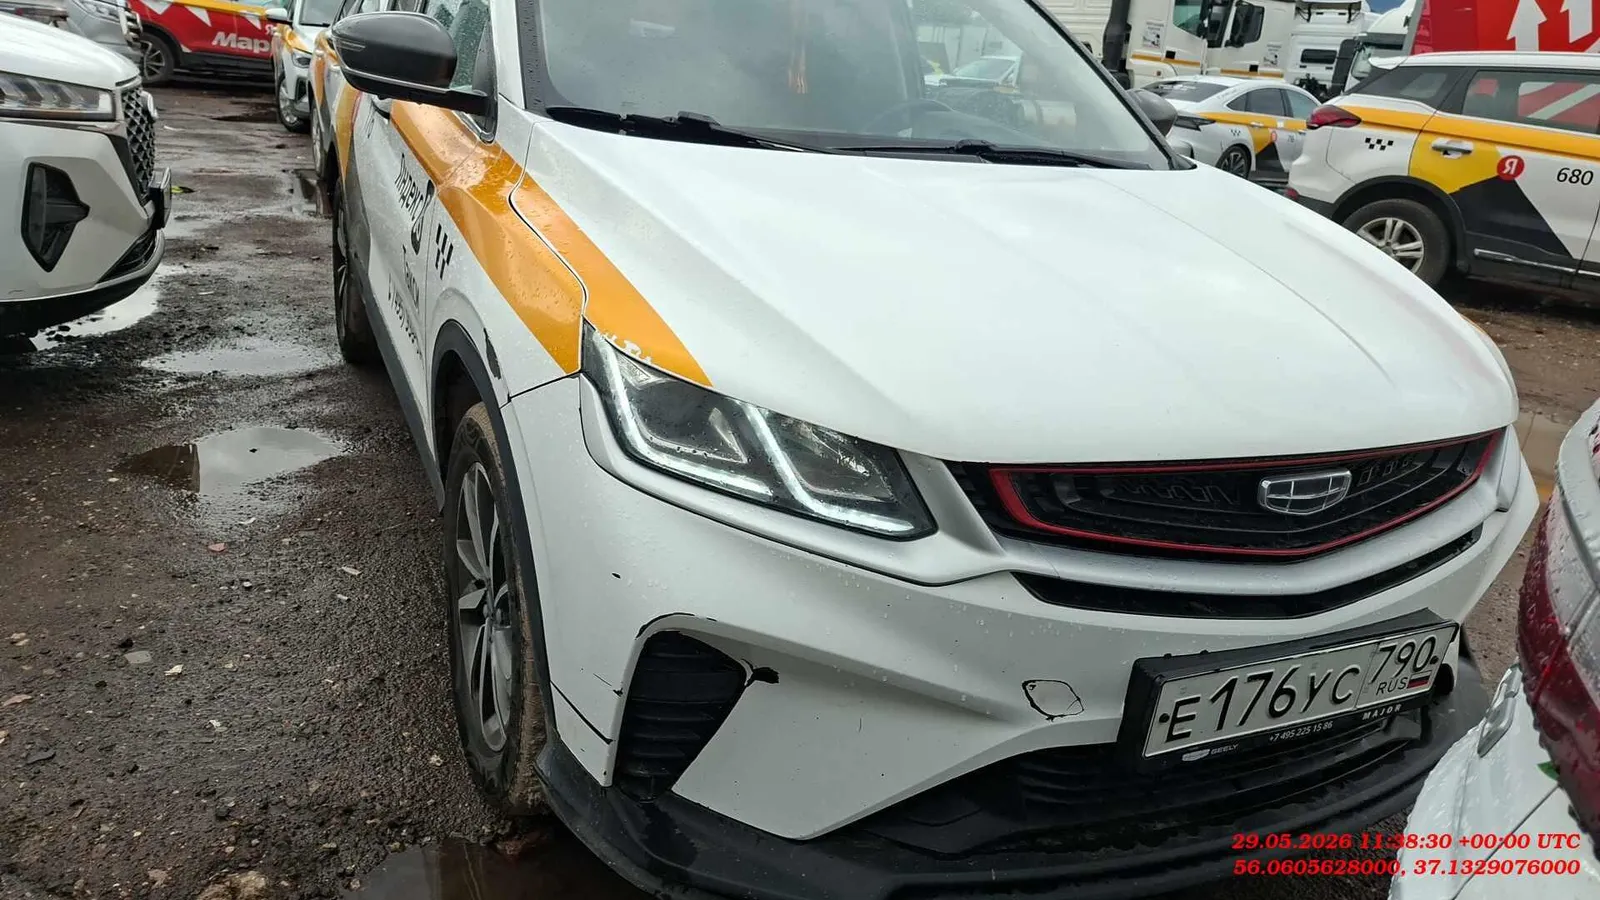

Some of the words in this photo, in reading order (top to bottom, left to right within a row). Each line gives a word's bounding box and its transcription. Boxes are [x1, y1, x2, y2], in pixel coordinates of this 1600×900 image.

[1556, 167, 1594, 186] 680
[1368, 636, 1437, 685] 790
[1375, 676, 1409, 696] RUS
[1362, 703, 1402, 720] MAJOR
[1280, 729, 1295, 739] 495
[1296, 725, 1312, 736] 225
[1313, 722, 1323, 732] 15
[1210, 743, 1239, 755] GEELY
